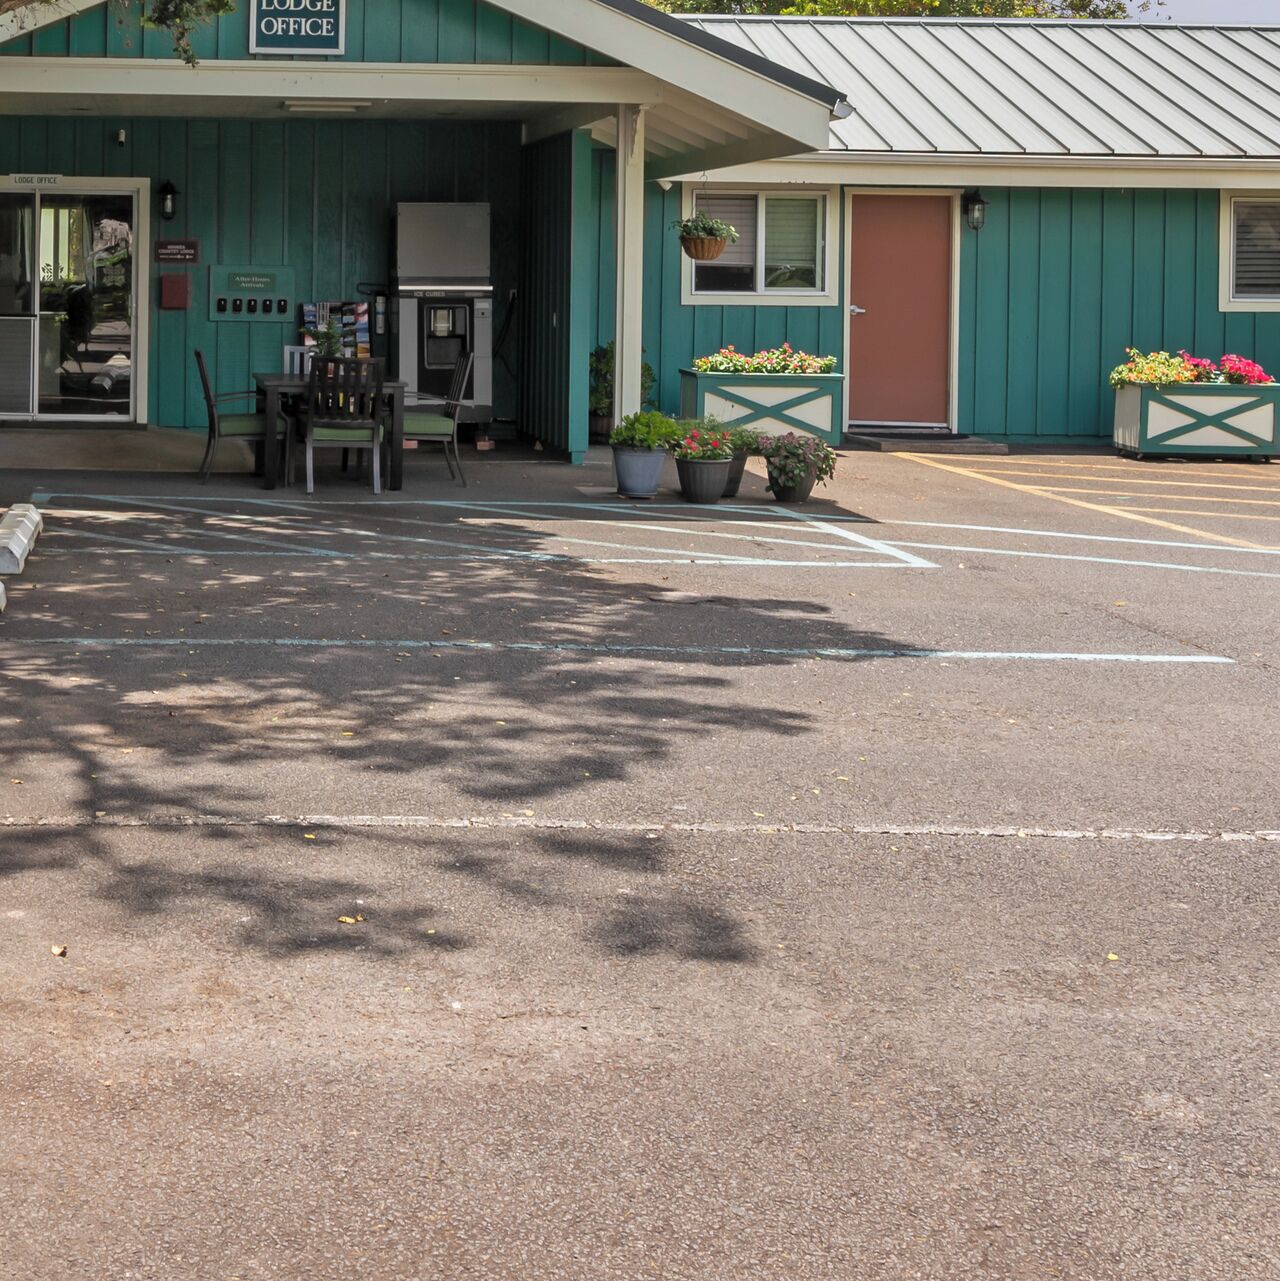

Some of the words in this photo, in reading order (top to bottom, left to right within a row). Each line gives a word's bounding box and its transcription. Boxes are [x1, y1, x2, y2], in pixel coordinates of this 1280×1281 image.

[260, 17, 335, 36] OFFICE
[14, 176, 34, 184] LODGE
[37, 176, 57, 184] OFFICE
